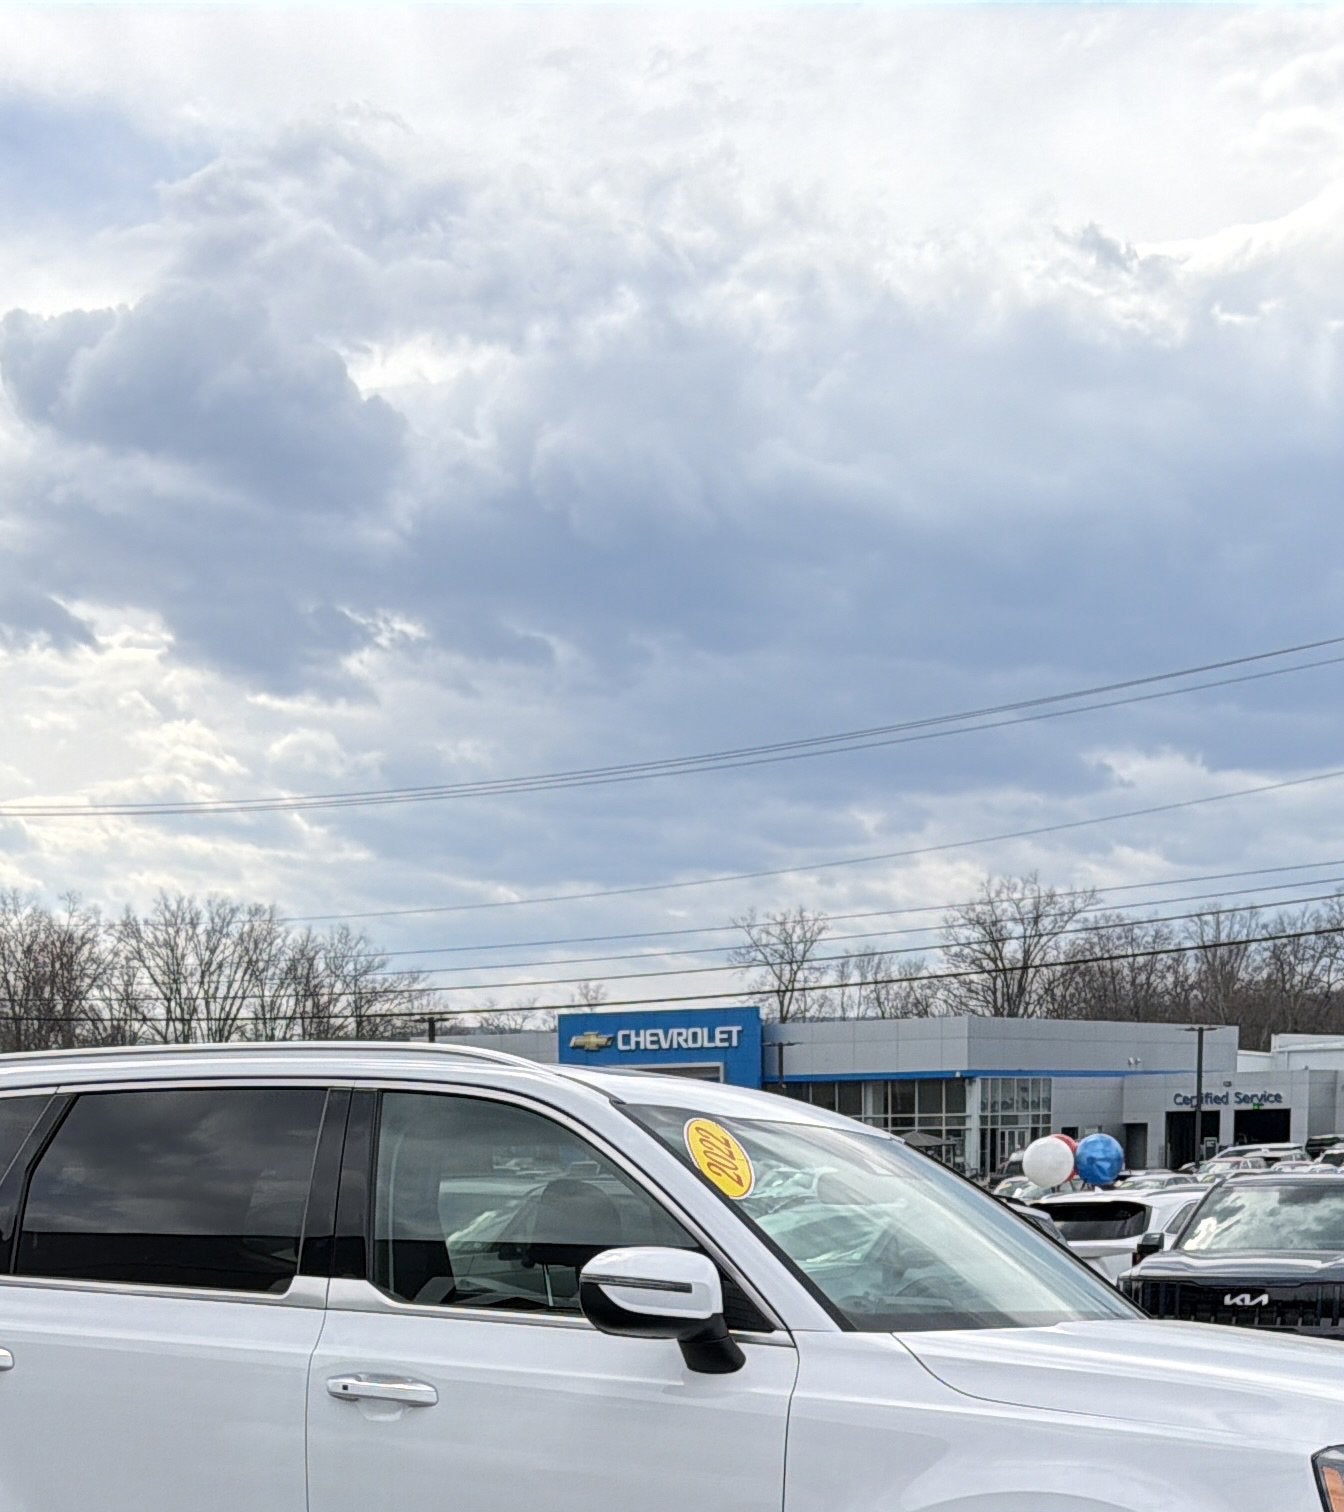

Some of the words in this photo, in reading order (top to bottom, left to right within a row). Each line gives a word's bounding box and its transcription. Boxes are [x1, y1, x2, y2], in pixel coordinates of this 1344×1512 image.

[617, 1026, 742, 1051] CHEVROLET
[1173, 1091, 1230, 1106] Cerified
[1234, 1091, 1283, 1105] Service
[695, 1127, 744, 1187] 2022
[1223, 1293, 1269, 1307] KIA
